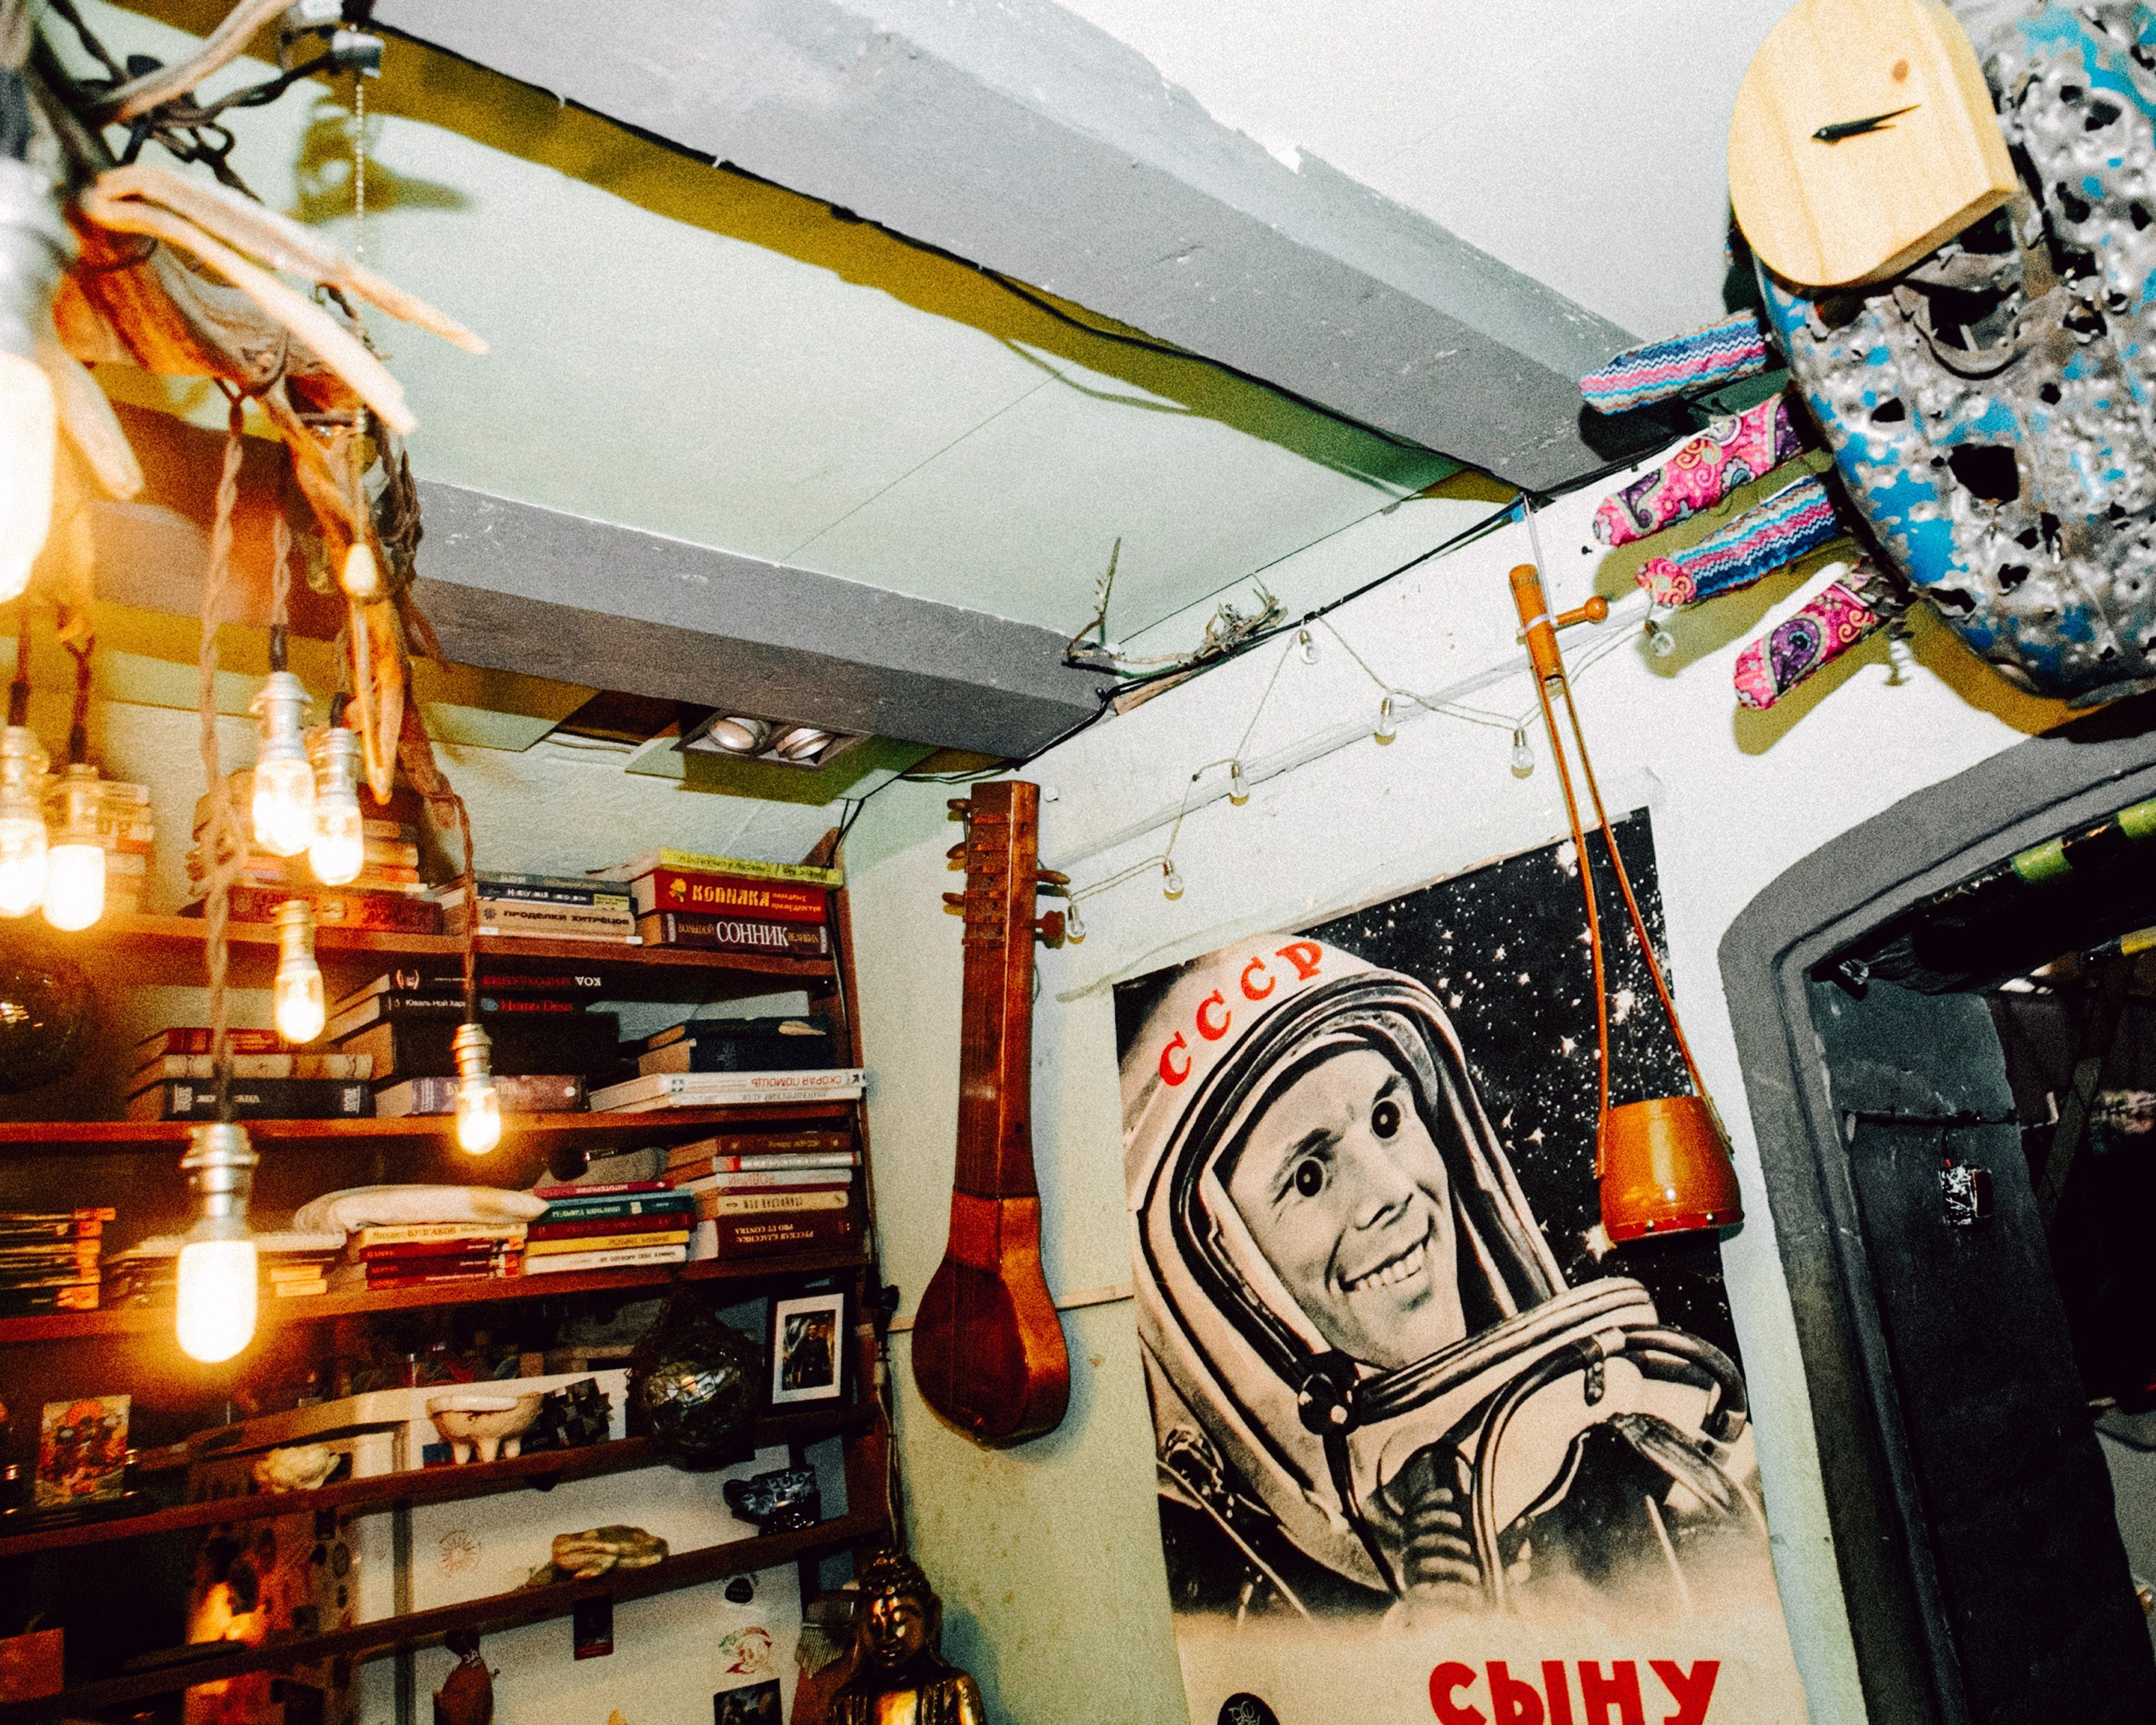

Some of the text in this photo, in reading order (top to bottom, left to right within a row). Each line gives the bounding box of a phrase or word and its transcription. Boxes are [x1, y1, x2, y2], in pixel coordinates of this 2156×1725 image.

[717, 921, 789, 947] СОННИК
[574, 975, 601, 987] КОД
[1159, 941, 1323, 1087] СССР
[751, 1076, 801, 1087] ПОМОЩЬ
[803, 1076, 842, 1087] СКОРАЯ
[1428, 1659, 1721, 1725] СЫНУ
